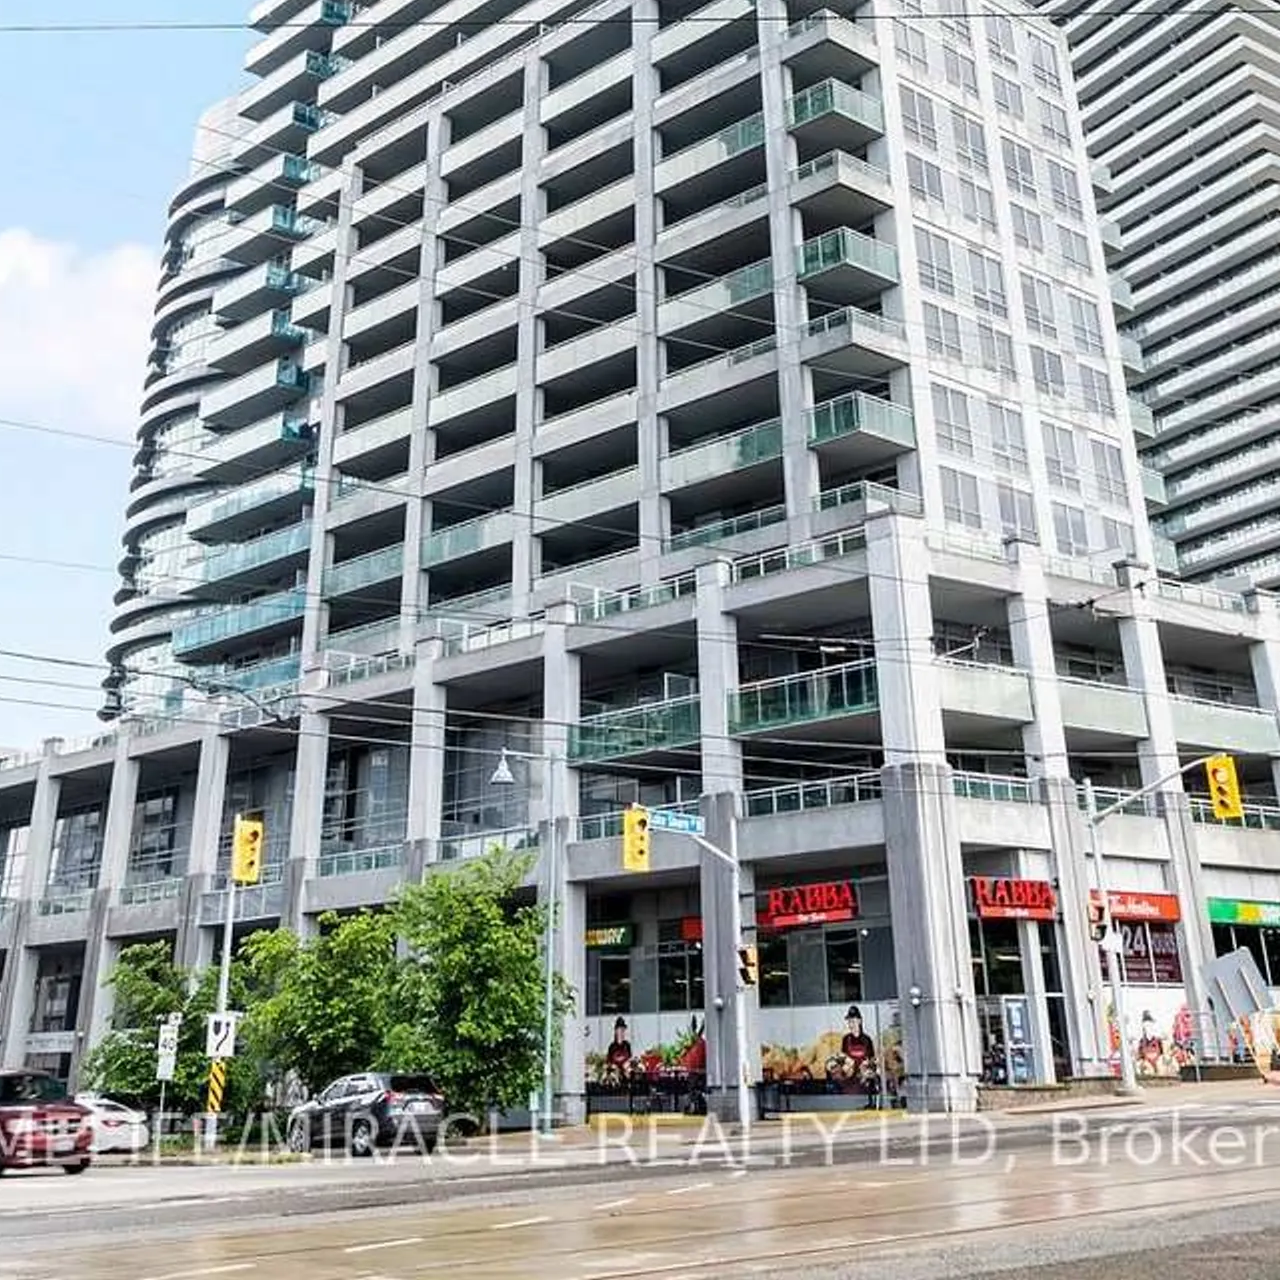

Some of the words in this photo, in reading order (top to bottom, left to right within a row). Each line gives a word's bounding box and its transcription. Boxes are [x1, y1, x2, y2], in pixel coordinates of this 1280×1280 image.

[768, 881, 856, 917] RABBA
[974, 877, 1057, 907] RABBA
[1122, 925, 1147, 957] 24
